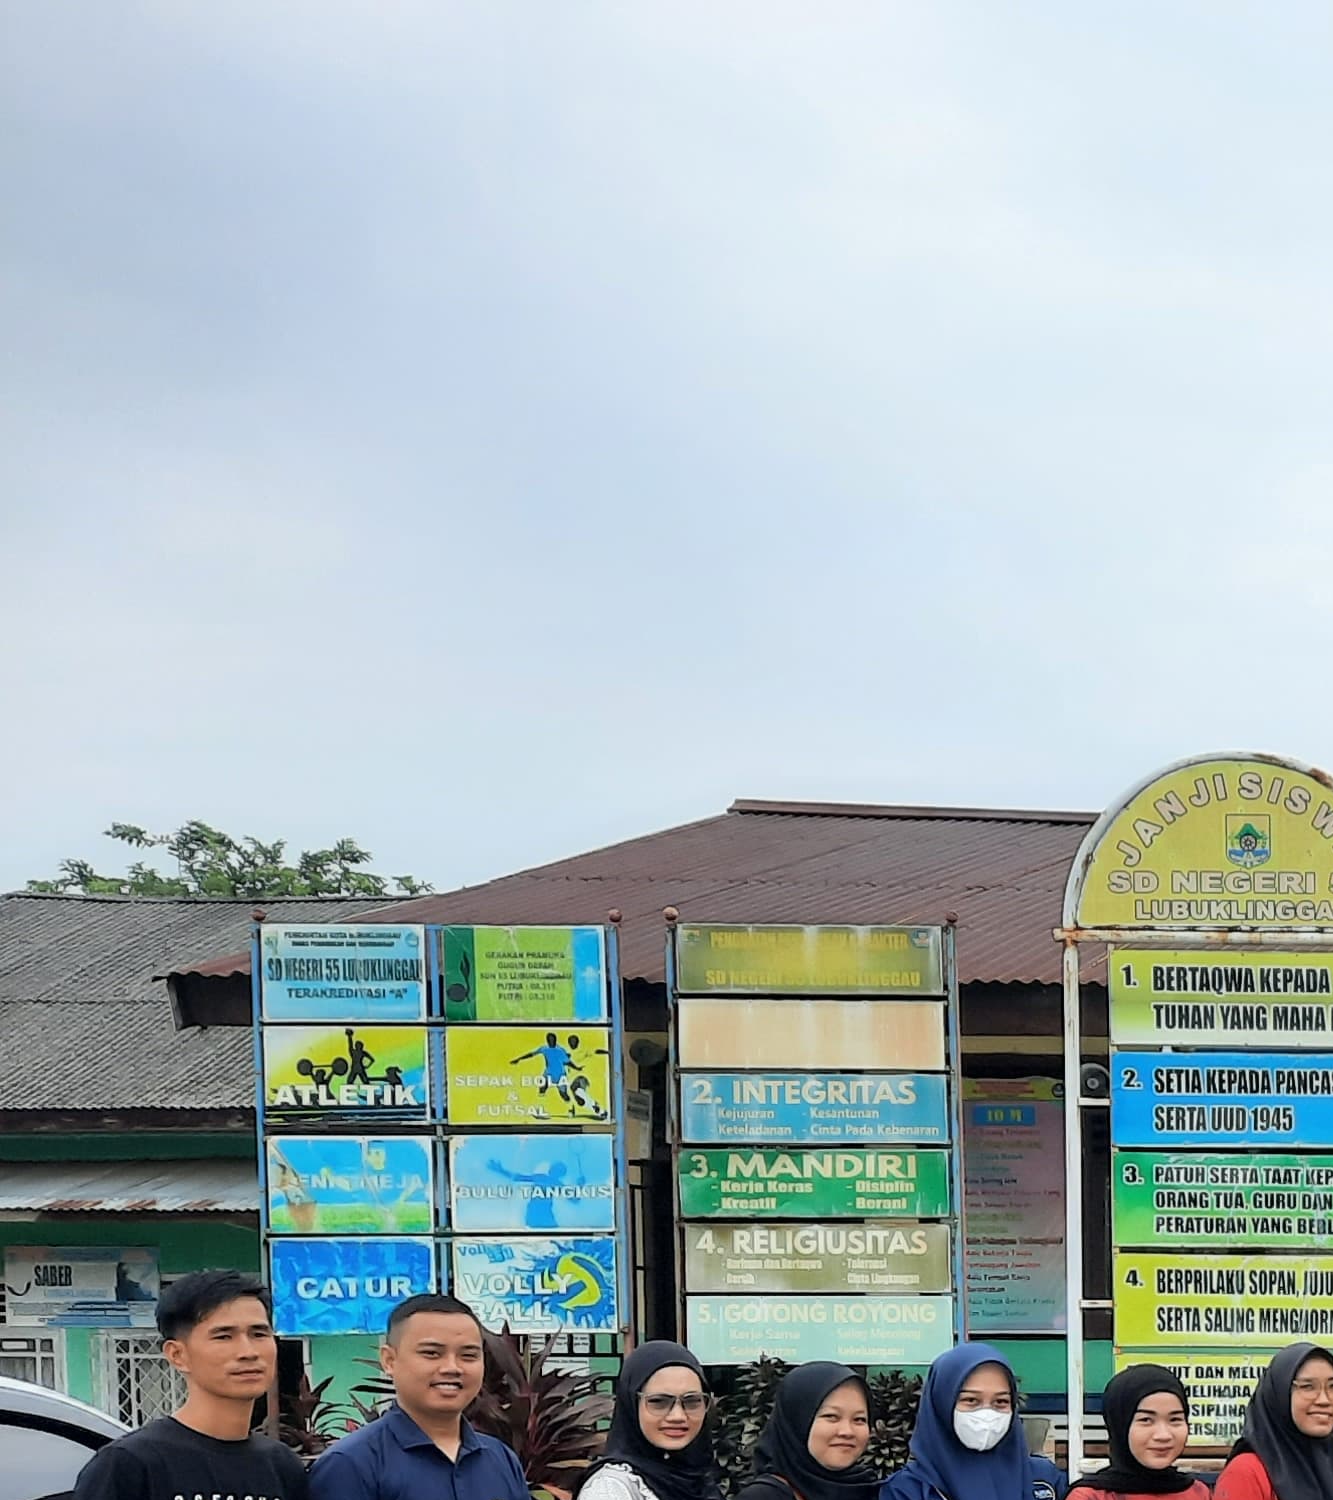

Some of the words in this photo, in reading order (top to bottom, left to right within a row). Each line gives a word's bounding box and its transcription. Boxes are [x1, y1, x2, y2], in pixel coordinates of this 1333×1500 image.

[1115, 773, 1228, 867] JANJI
[1107, 871, 1160, 894] SD
[1171, 871, 1316, 895] NEGERI
[267, 957, 282, 982] SD
[325, 958, 340, 982] 55
[1121, 965, 1137, 987] 1.
[1152, 967, 1253, 995] BERTAQWA
[1259, 968, 1331, 993] KEPADA
[1153, 1004, 1215, 1030] TUHAN
[1219, 1005, 1268, 1031] YANG
[1272, 1006, 1327, 1032] MAHA
[455, 1075, 514, 1087] SEPAK
[521, 1075, 570, 1088] BOLA
[692, 1080, 722, 1104] 2.
[733, 1080, 917, 1105] INTEGRITAS
[1122, 1069, 1142, 1088] 2.
[1153, 1068, 1202, 1094] SETIA
[1206, 1069, 1272, 1095] KEPADA
[274, 1084, 418, 1106] ATLETIK
[477, 1104, 548, 1117] FUTSAL
[1154, 1106, 1208, 1132] SERTA
[1210, 1106, 1247, 1132] UUD
[1250, 1107, 1294, 1132] 1945
[810, 1125, 843, 1136] Cinta
[845, 1125, 873, 1136] Pada
[877, 1125, 940, 1136] Kebenaran
[689, 1155, 718, 1178] 3.
[727, 1154, 917, 1178] MANDIRI
[1124, 1166, 1143, 1183] 3.
[1154, 1166, 1205, 1185] PATUH
[1209, 1167, 1259, 1185] SERTA
[1263, 1168, 1301, 1185] TAAT
[459, 1185, 512, 1198] BULU
[521, 1185, 612, 1198] TANGKIS
[720, 1181, 765, 1193] Kerja
[767, 1181, 813, 1192] Keras
[1155, 1191, 1209, 1209] ORANG
[1252, 1193, 1297, 1210] GURU
[1301, 1193, 1333, 1210] DAN
[1155, 1217, 1247, 1234] PERATURAN
[1251, 1217, 1293, 1234] YANG
[695, 1230, 724, 1254] 4.
[733, 1230, 928, 1255] RELIGIUSITAS
[34, 1265, 73, 1286] SABER
[464, 1273, 573, 1295] VOLLY
[1125, 1270, 1144, 1287] 4.
[1157, 1269, 1245, 1295] BERPRILAKU
[296, 1276, 414, 1299] CATUR
[470, 1301, 553, 1322] BALL
[724, 1303, 828, 1324] GOTONG
[833, 1303, 936, 1324] ROYONG
[1157, 1307, 1201, 1332] SERTA
[1204, 1308, 1255, 1334] SALING
[1195, 1366, 1224, 1379] DAN
